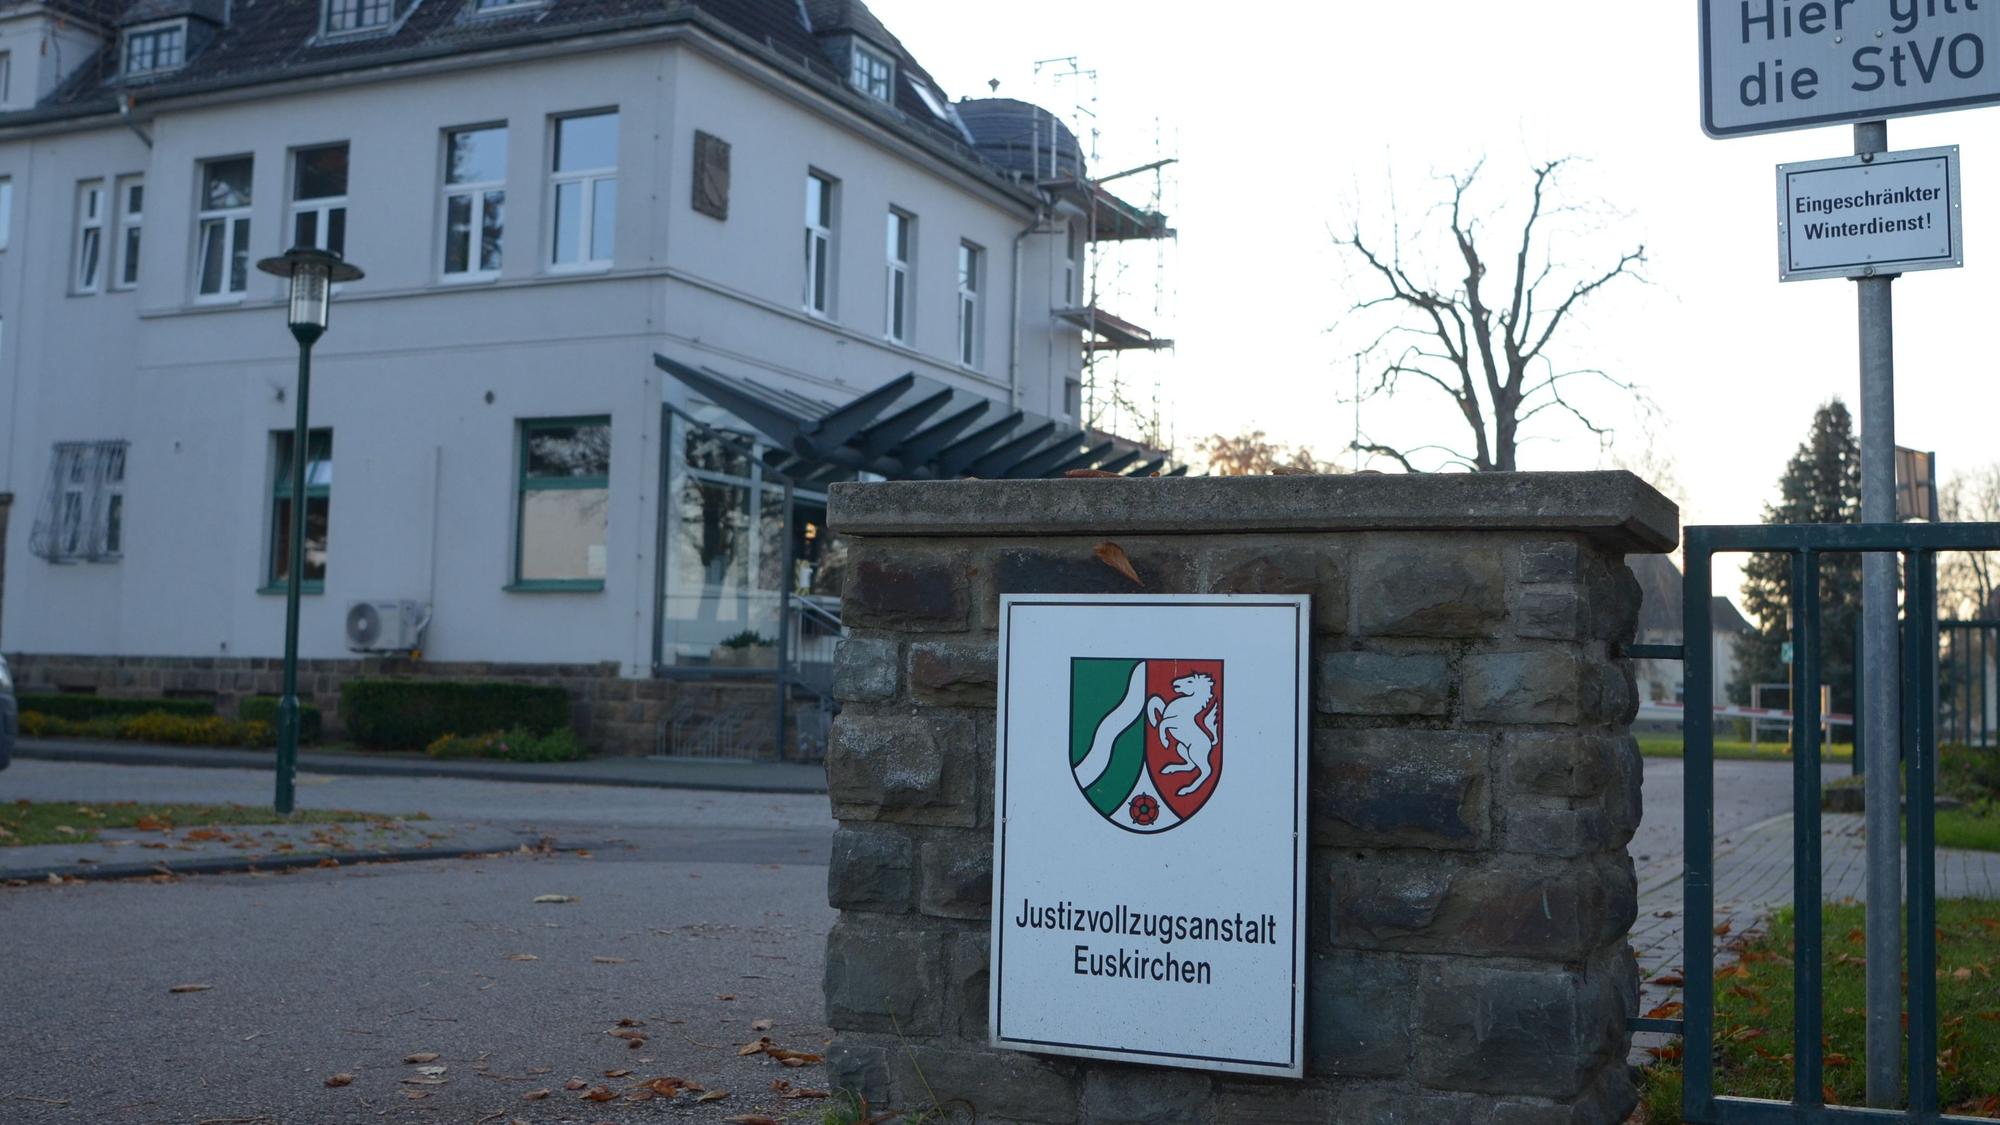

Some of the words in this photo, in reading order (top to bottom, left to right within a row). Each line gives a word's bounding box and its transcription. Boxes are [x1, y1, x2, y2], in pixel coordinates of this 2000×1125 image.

[1741, 0, 1854, 44] Hier
[1739, 59, 1819, 107] die
[1851, 33, 1984, 92] StVO
[1795, 187, 1941, 214] Eingeschränkter
[1804, 212, 1932, 240] Winterdienst!
[1016, 898, 1277, 945] Justizvollzugsanstalt
[1074, 945, 1211, 985] Euskirchen
